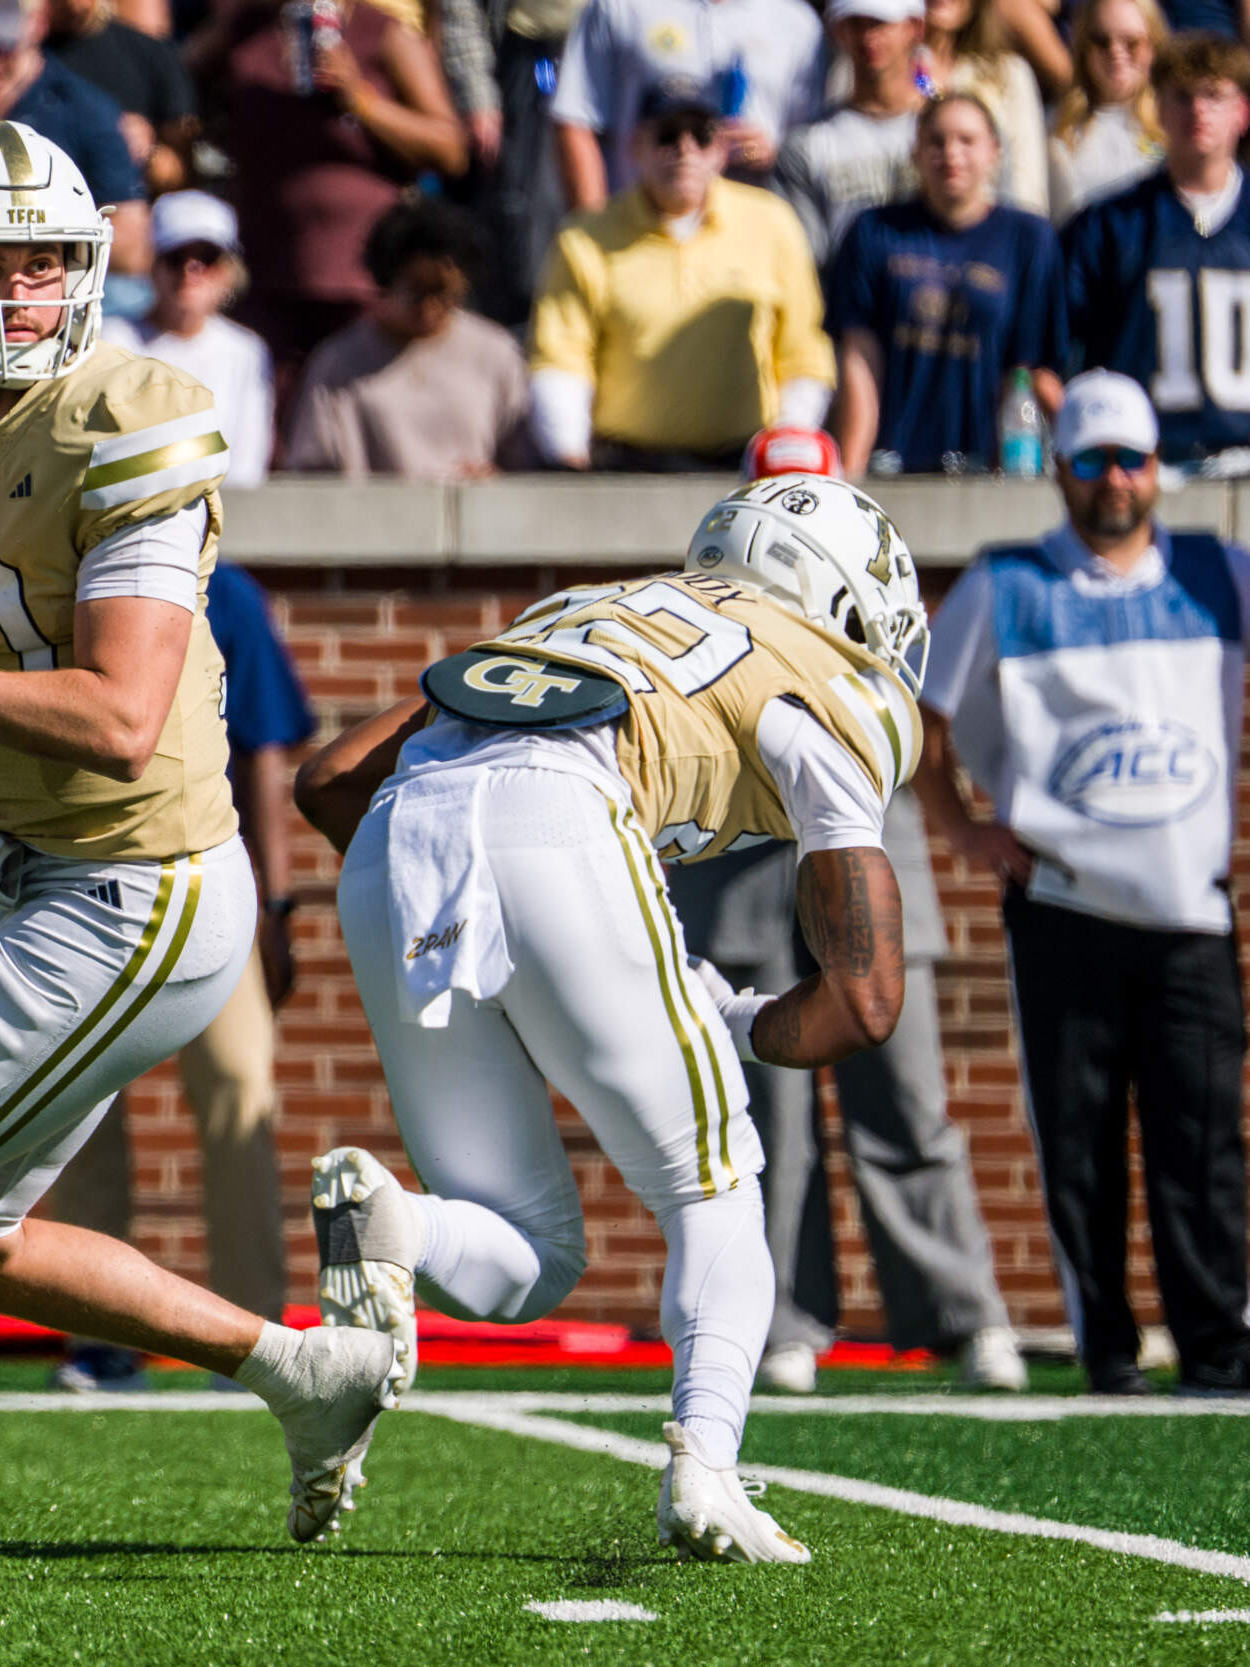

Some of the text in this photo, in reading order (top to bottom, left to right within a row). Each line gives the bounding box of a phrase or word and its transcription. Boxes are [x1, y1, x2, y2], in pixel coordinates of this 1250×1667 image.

[6, 208, 46, 225] TECH
[1146, 267, 1250, 412] 10
[463, 655, 582, 708] GT
[1074, 745, 1197, 785] ACC
